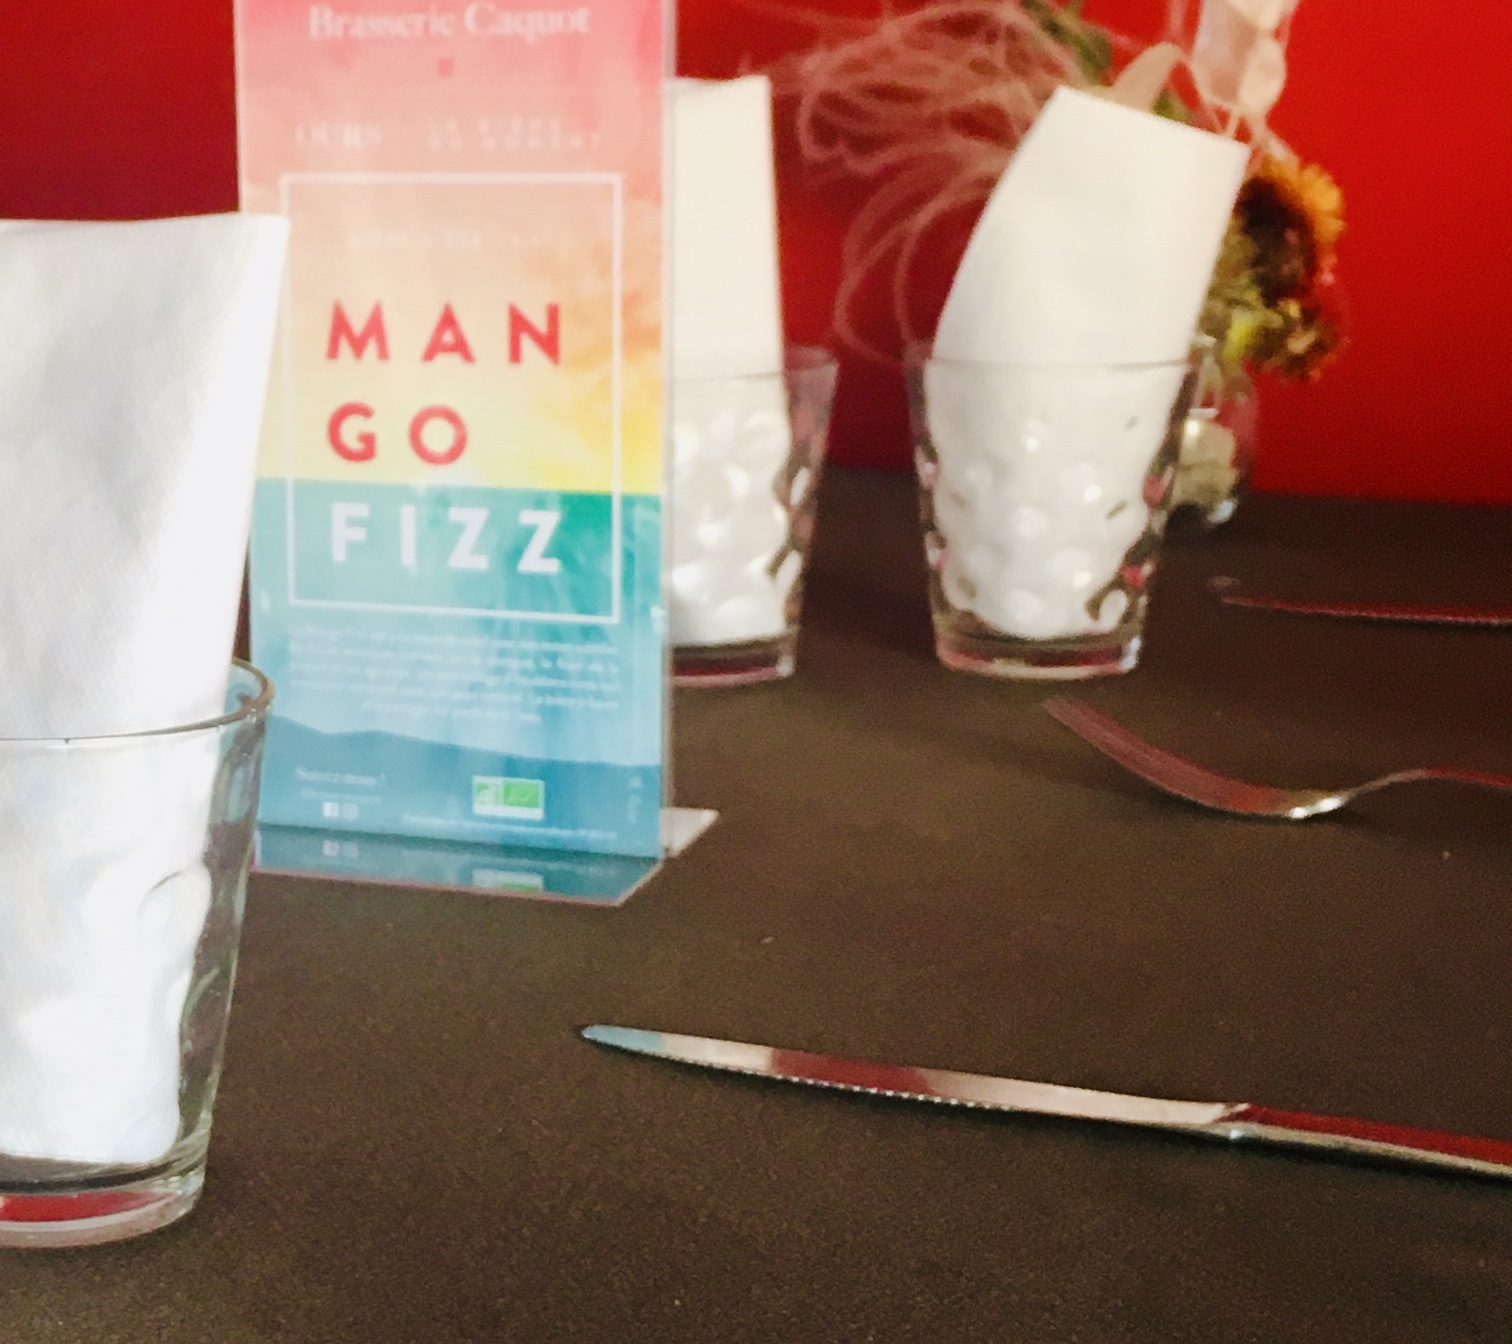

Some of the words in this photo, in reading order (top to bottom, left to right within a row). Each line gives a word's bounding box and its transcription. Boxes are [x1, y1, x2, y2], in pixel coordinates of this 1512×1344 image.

[308, 3, 456, 40] Brasserie
[464, 0, 591, 43] Caquot
[326, 298, 562, 366] MAN
[327, 401, 469, 466] GO
[331, 501, 561, 574] FIZZ
